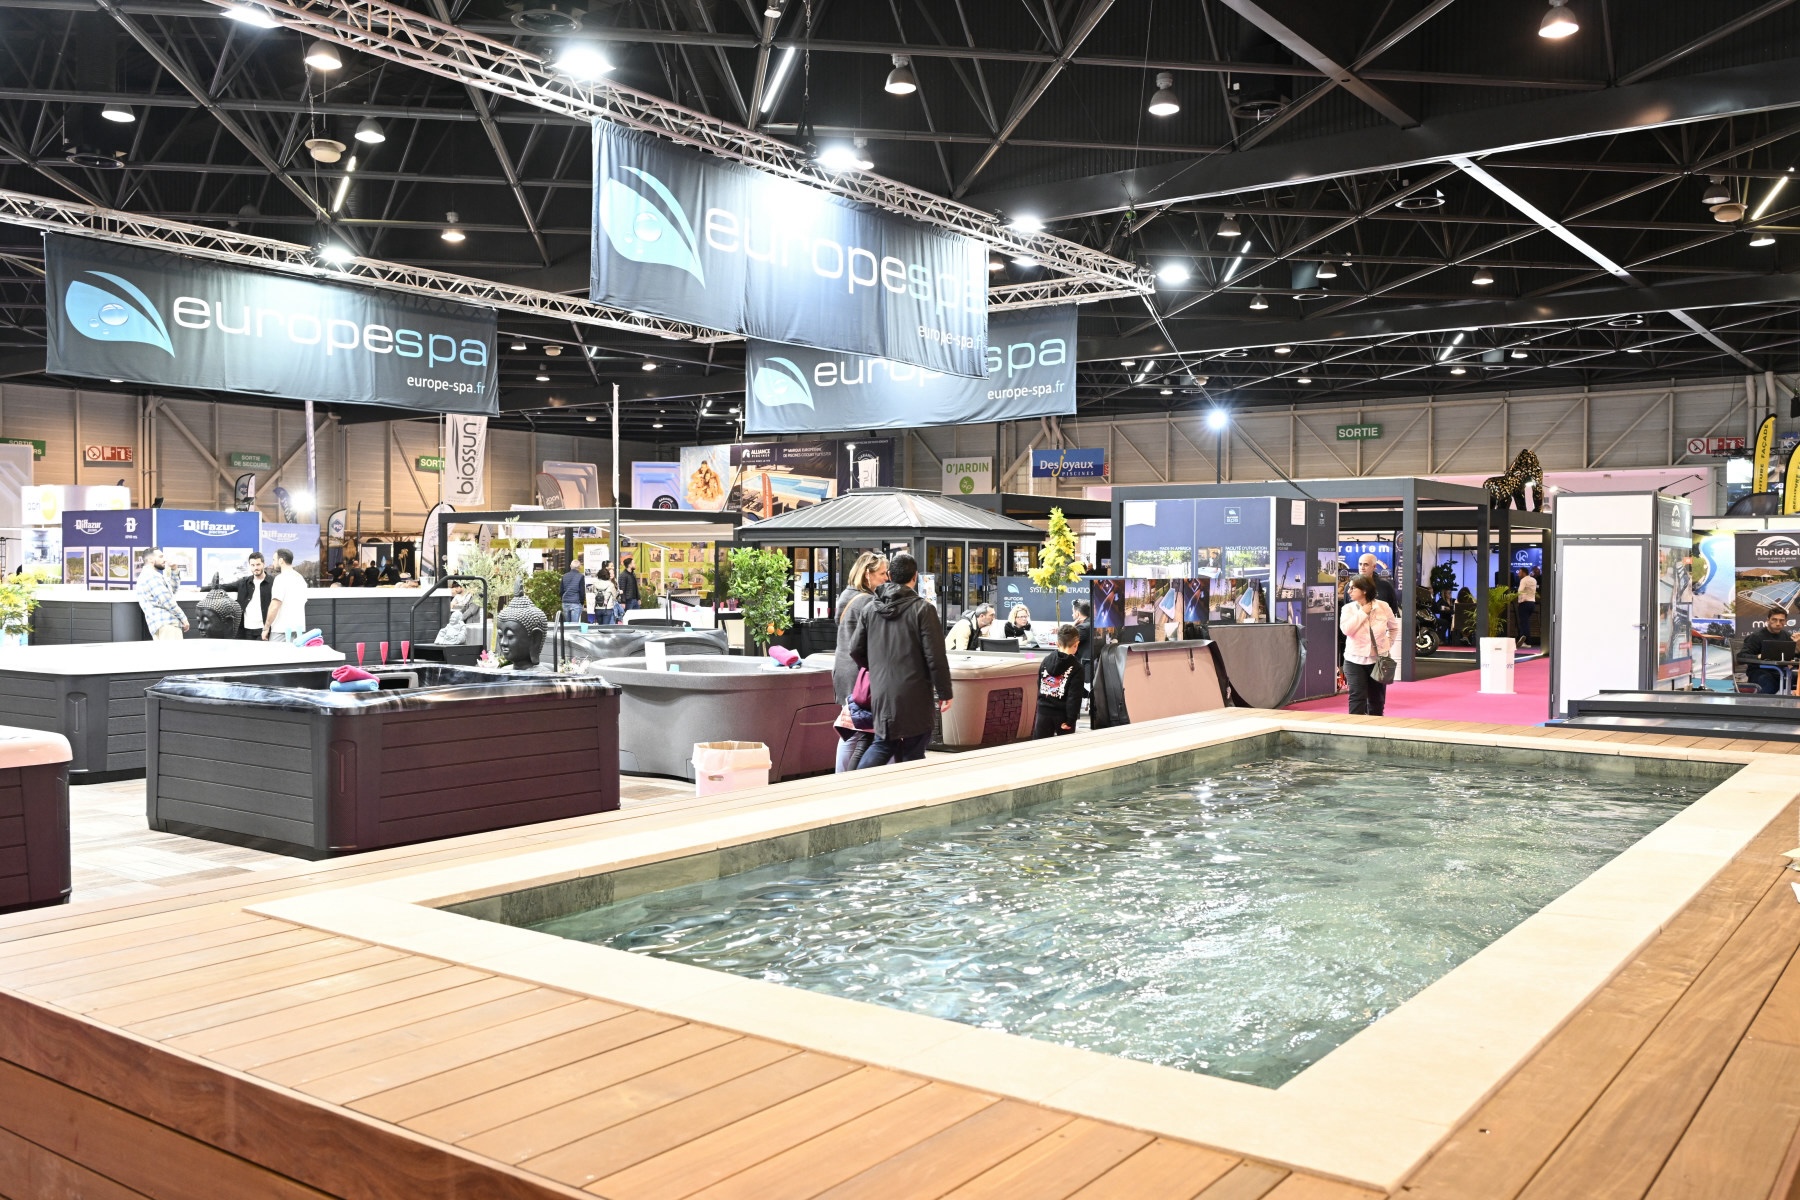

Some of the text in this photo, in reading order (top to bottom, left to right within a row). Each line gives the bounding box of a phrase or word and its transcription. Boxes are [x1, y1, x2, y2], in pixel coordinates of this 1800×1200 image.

[173, 296, 487, 368] europespa
[814, 337, 1066, 388] europspa
[407, 375, 486, 395] europe-spa.fr
[987, 379, 1065, 400] europe-spa.fr
[1338, 427, 1379, 438] SORTIE
[1760, 424, 1769, 459] FAÇADE
[420, 458, 445, 468] SORTI
[457, 421, 477, 495] biossun
[946, 462, 989, 475] O'JARDIN
[75, 519, 102, 530] Diffazur
[183, 519, 236, 531] Diffazur
